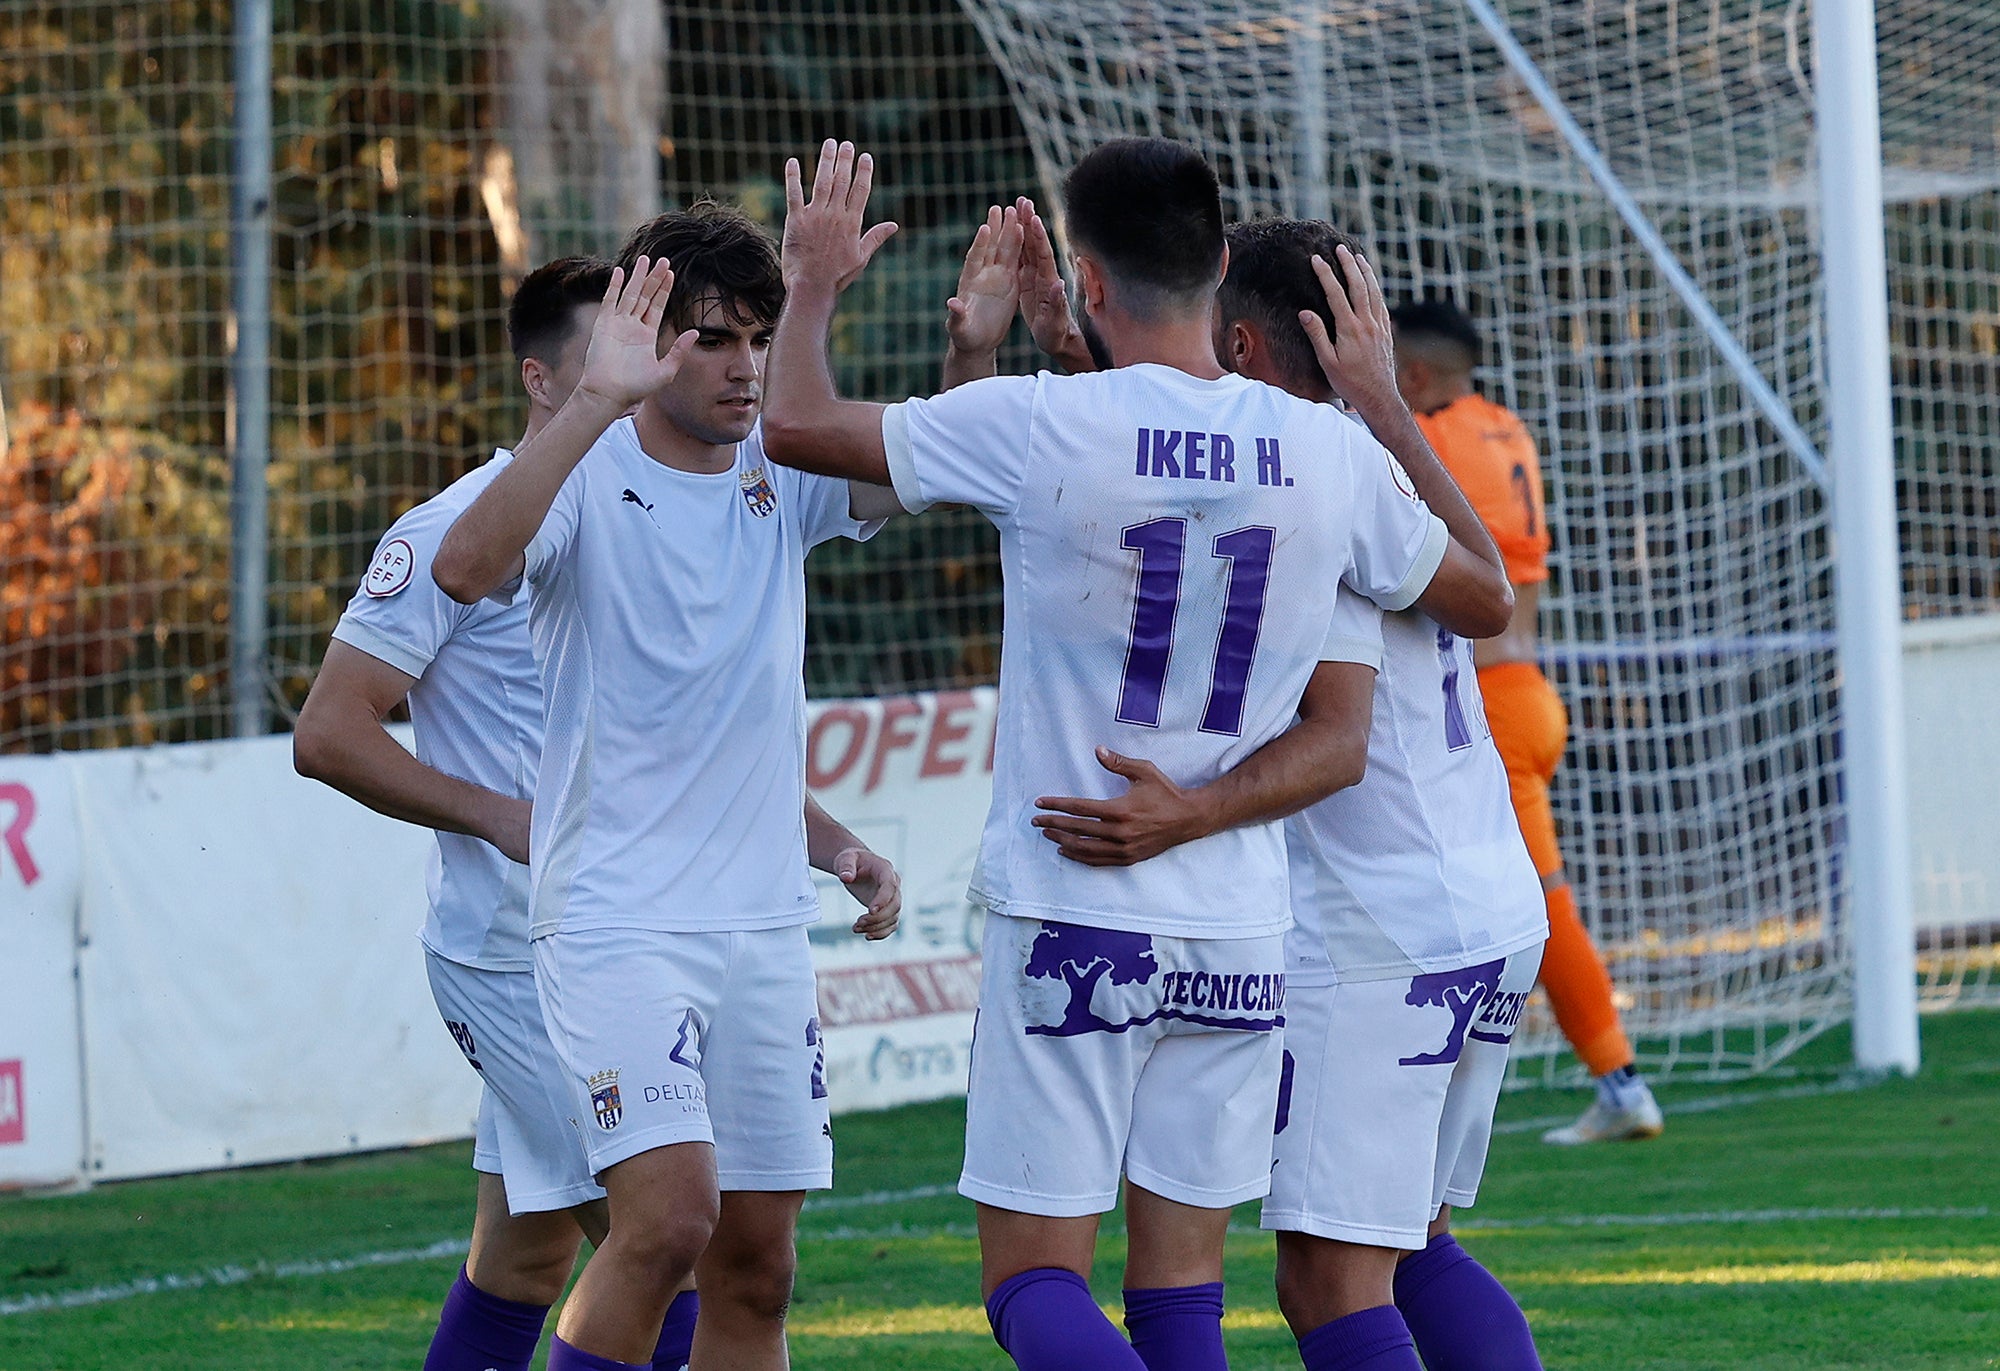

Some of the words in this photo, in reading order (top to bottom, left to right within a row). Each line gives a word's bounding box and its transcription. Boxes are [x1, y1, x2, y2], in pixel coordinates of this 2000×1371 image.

[1135, 427, 1236, 483] IKER
[1255, 437, 1294, 487] H.
[372, 567, 394, 583] EF
[383, 552, 405, 567] RF
[1115, 516, 1276, 737] 11
[808, 690, 997, 795] OFE
